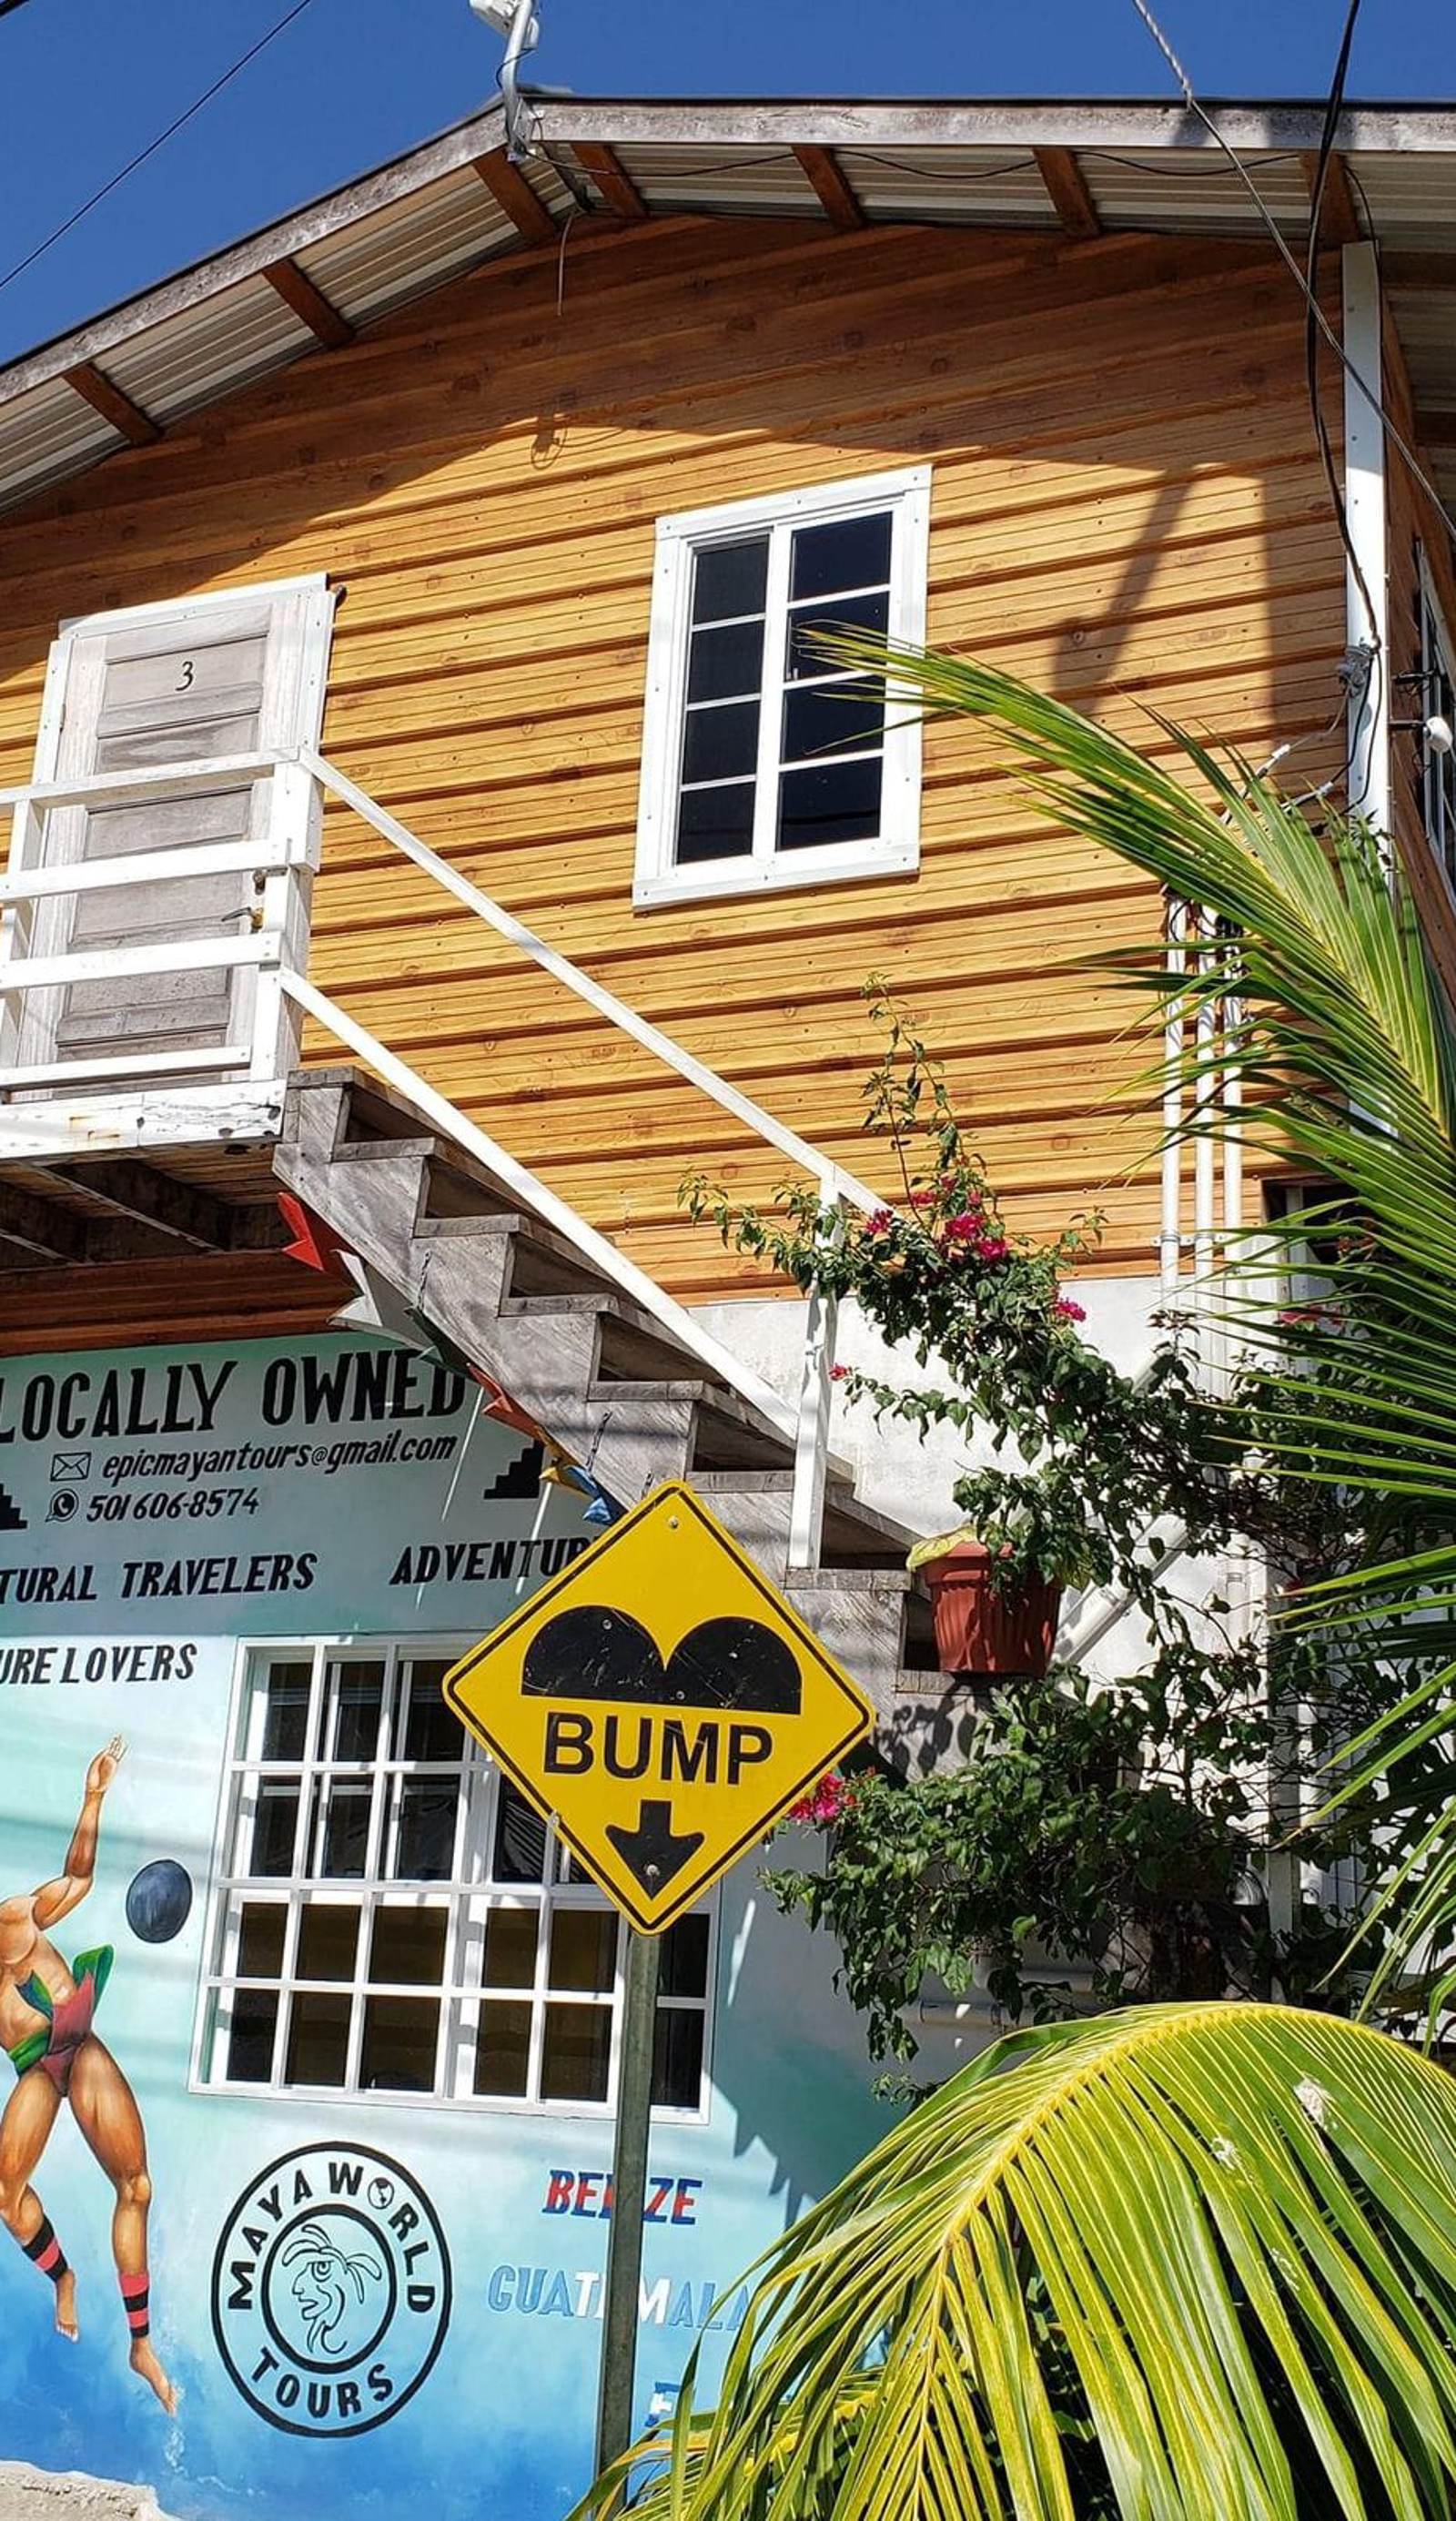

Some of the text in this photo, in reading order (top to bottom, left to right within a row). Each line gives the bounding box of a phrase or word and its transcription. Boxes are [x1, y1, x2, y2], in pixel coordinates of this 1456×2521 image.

[176, 661, 193, 692] 3
[262, 1349, 465, 1426] OWNED
[102, 1429, 457, 1487] epicmayantours@gmail.com
[86, 1488, 260, 1522] 501 606-8574
[121, 1554, 318, 1598] TRAVELERS
[389, 1536, 601, 1584] ADVENTUR
[60, 1644, 197, 1684] LOVERS
[543, 1712, 774, 1786] BUMP
[542, 2170, 703, 2225] BEZE
[228, 2170, 313, 2309] MAYA
[488, 2265, 750, 2331] GUATMALA
[251, 2347, 393, 2418] TOURS
